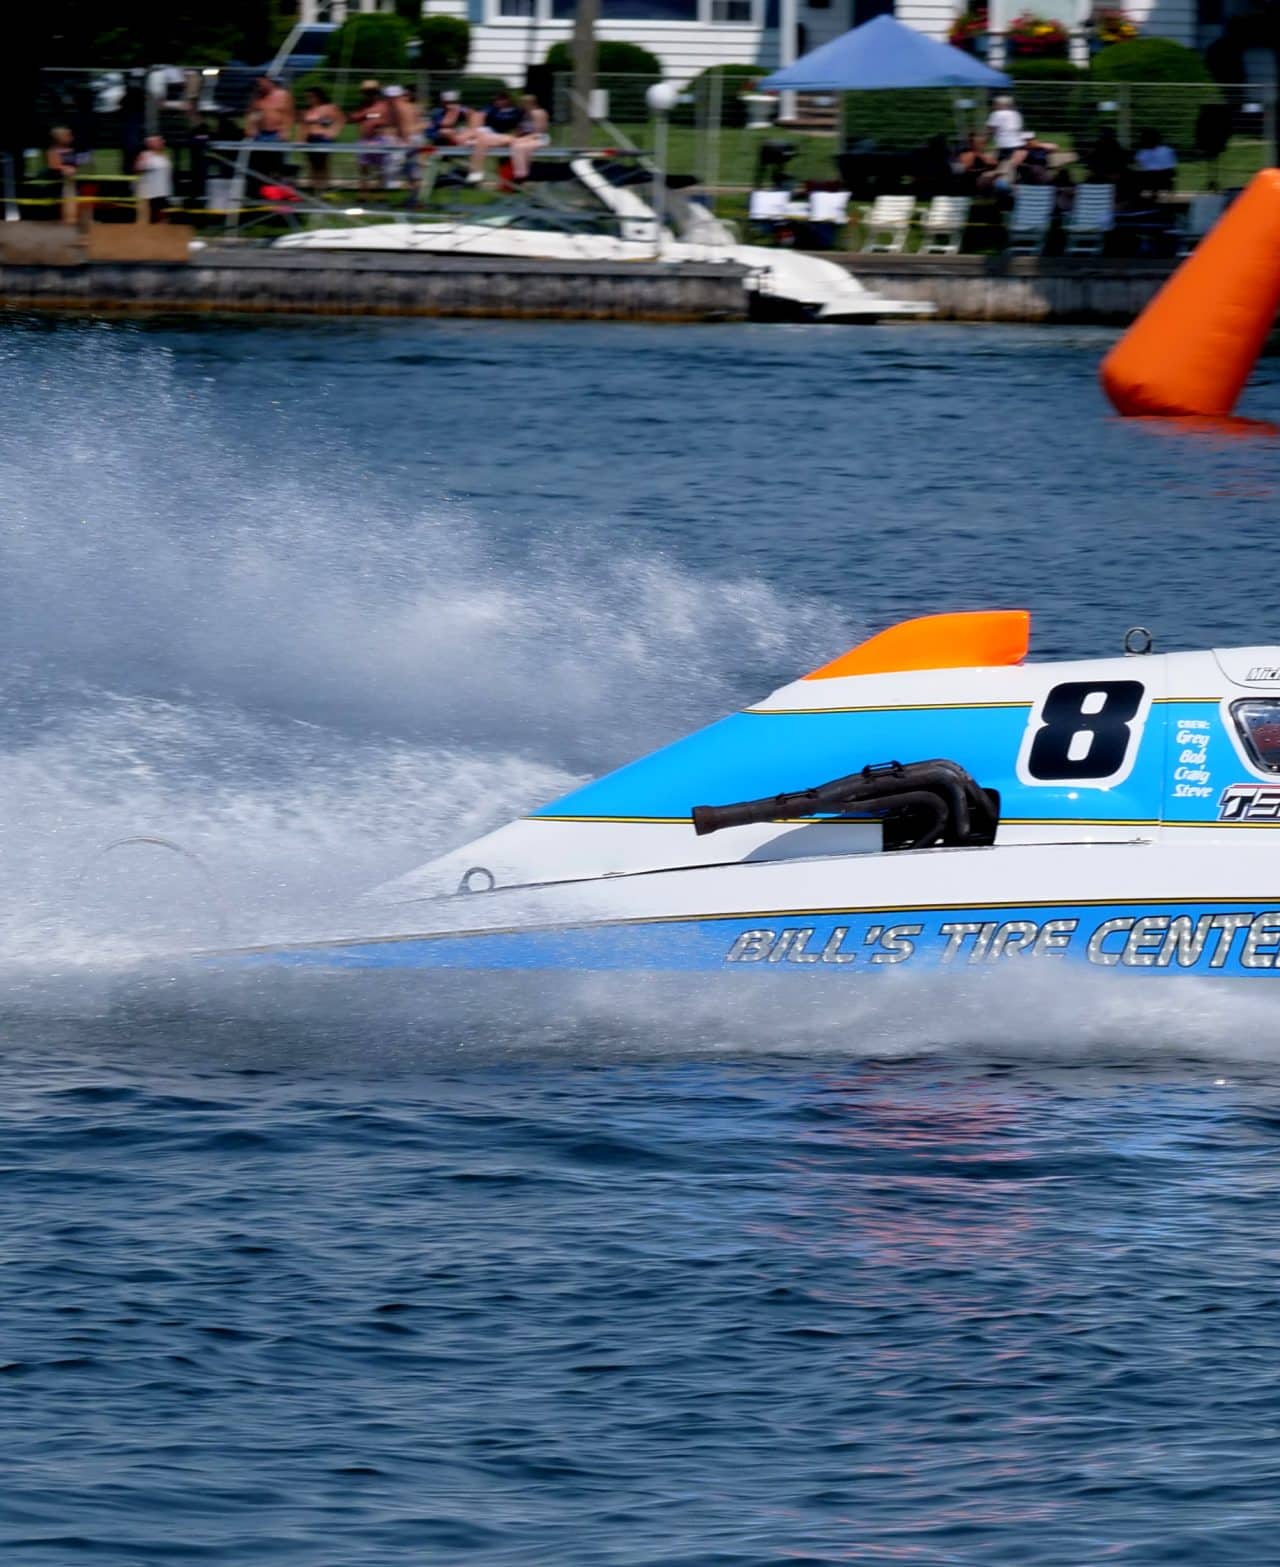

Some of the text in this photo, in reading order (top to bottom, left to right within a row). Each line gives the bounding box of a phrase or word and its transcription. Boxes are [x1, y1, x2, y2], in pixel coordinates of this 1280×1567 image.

[1029, 681, 1143, 779] 8
[1179, 748, 1207, 764] Bob
[1174, 764, 1211, 785] Craig
[1170, 784, 1214, 797] Steve
[724, 926, 922, 963] BILL'S
[936, 919, 1079, 965] TIRE
